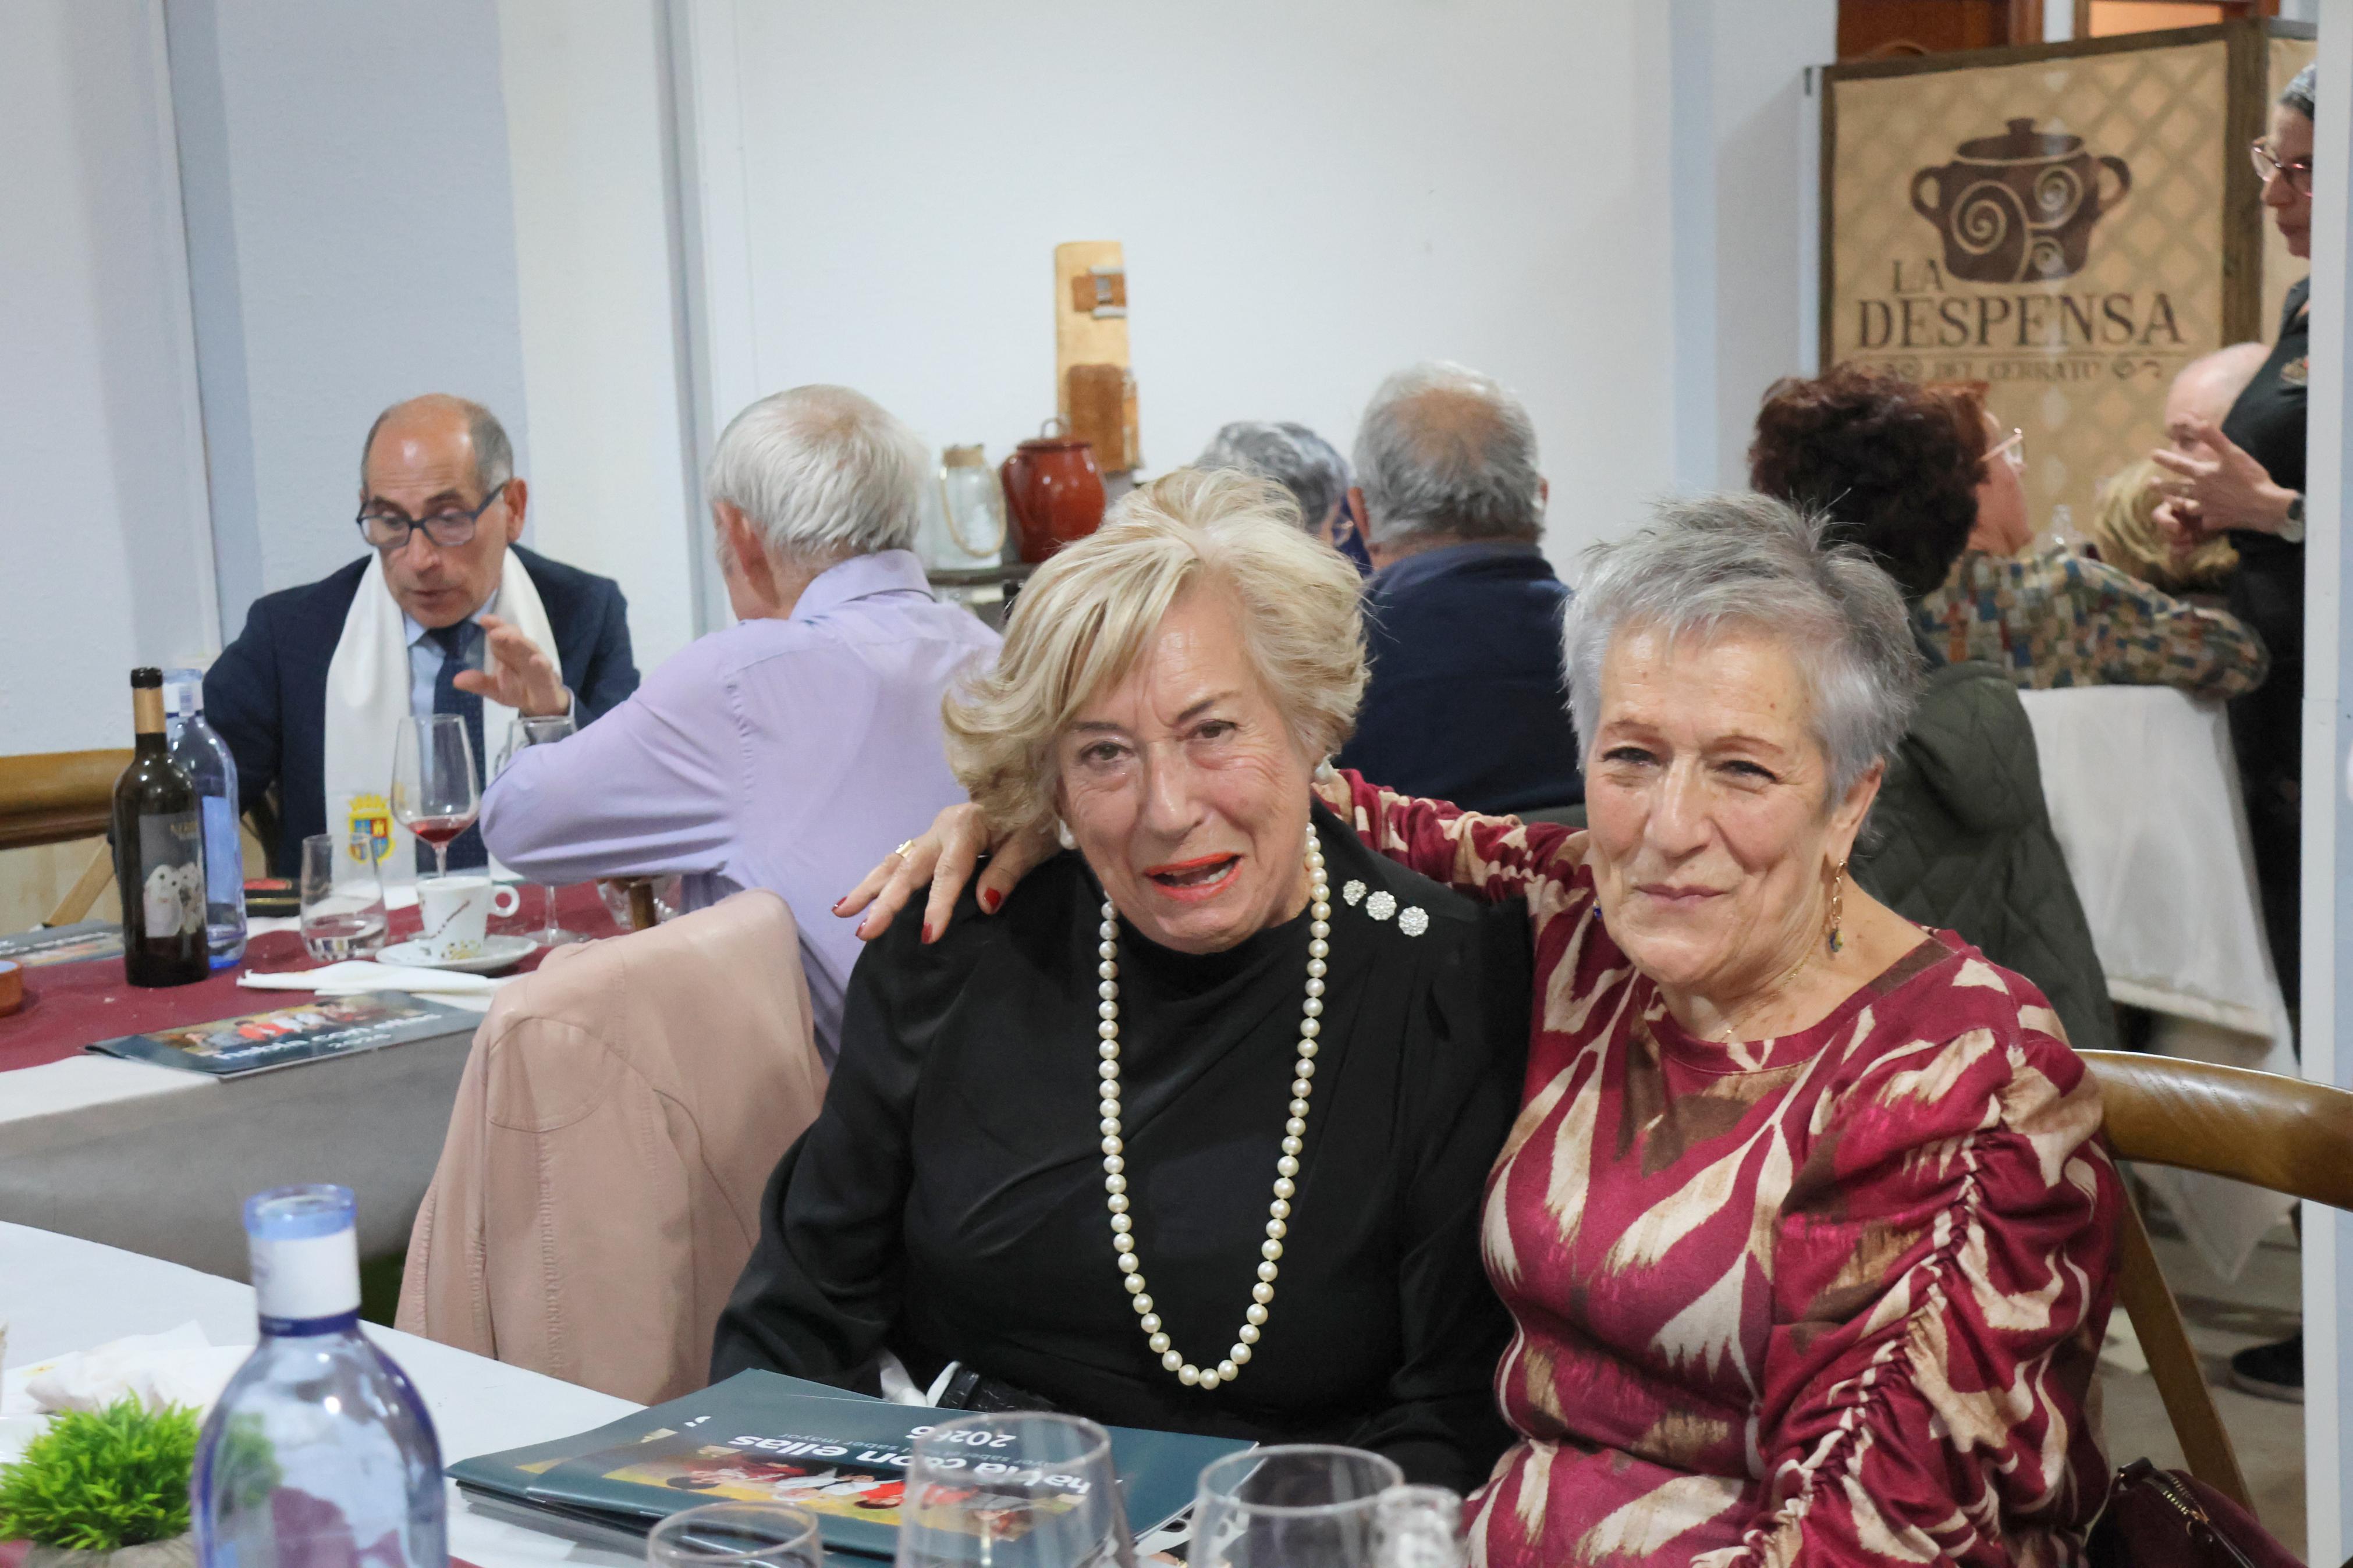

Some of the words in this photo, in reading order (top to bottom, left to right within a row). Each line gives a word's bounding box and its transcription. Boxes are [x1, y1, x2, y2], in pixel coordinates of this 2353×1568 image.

[1892, 259, 1944, 290] LA
[1858, 293, 2186, 349] DESPENSA
[728, 1436, 848, 1456] ellas
[778, 1432, 840, 1444] mayor
[843, 1441, 899, 1451] saber
[856, 1451, 967, 1470] con
